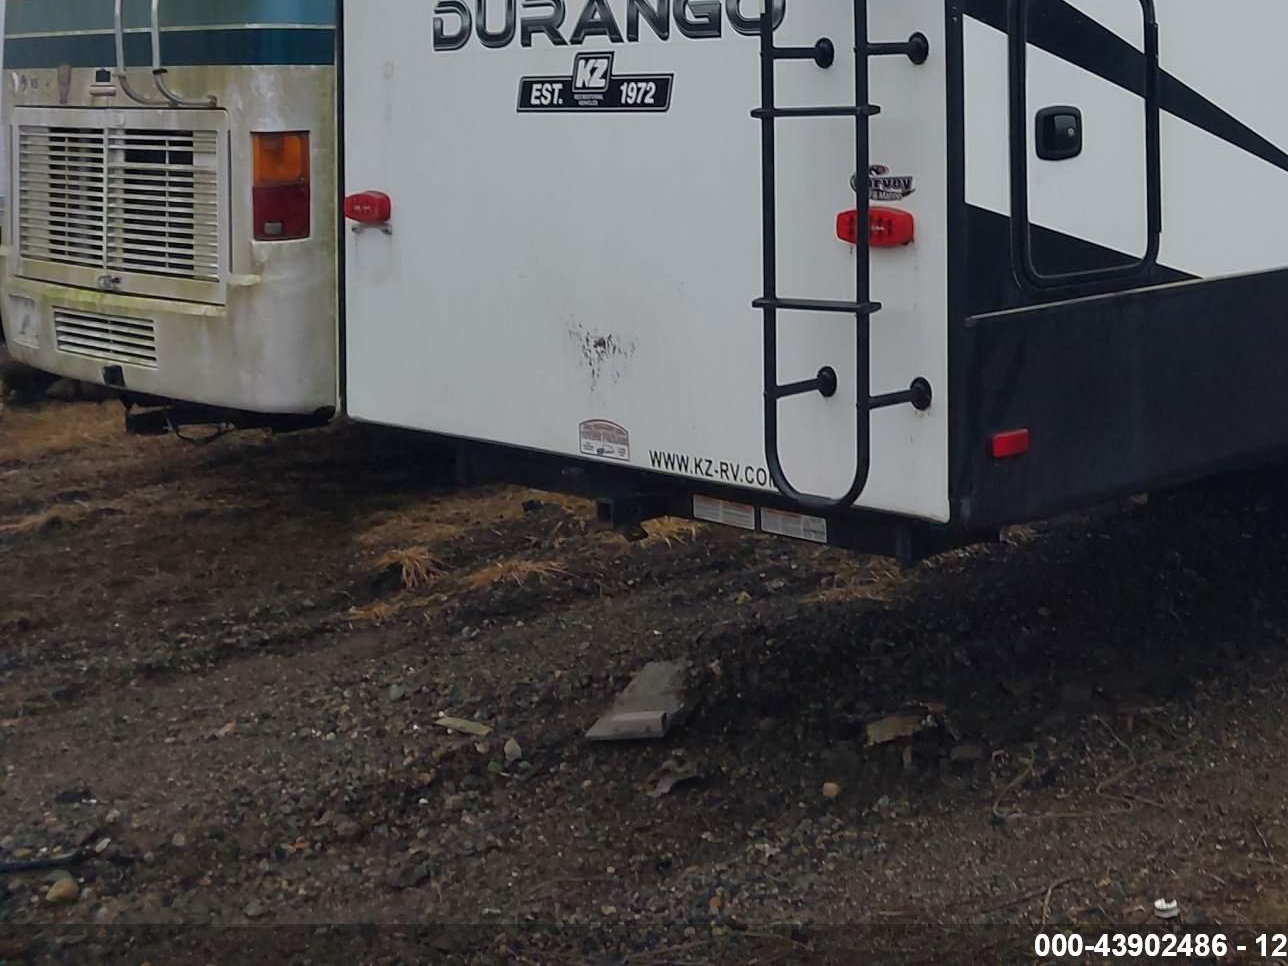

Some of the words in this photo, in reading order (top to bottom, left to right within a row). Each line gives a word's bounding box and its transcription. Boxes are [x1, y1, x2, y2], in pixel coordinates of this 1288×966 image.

[575, 58, 609, 88] KZ
[530, 83, 563, 105] EST.
[619, 81, 656, 104] 1972
